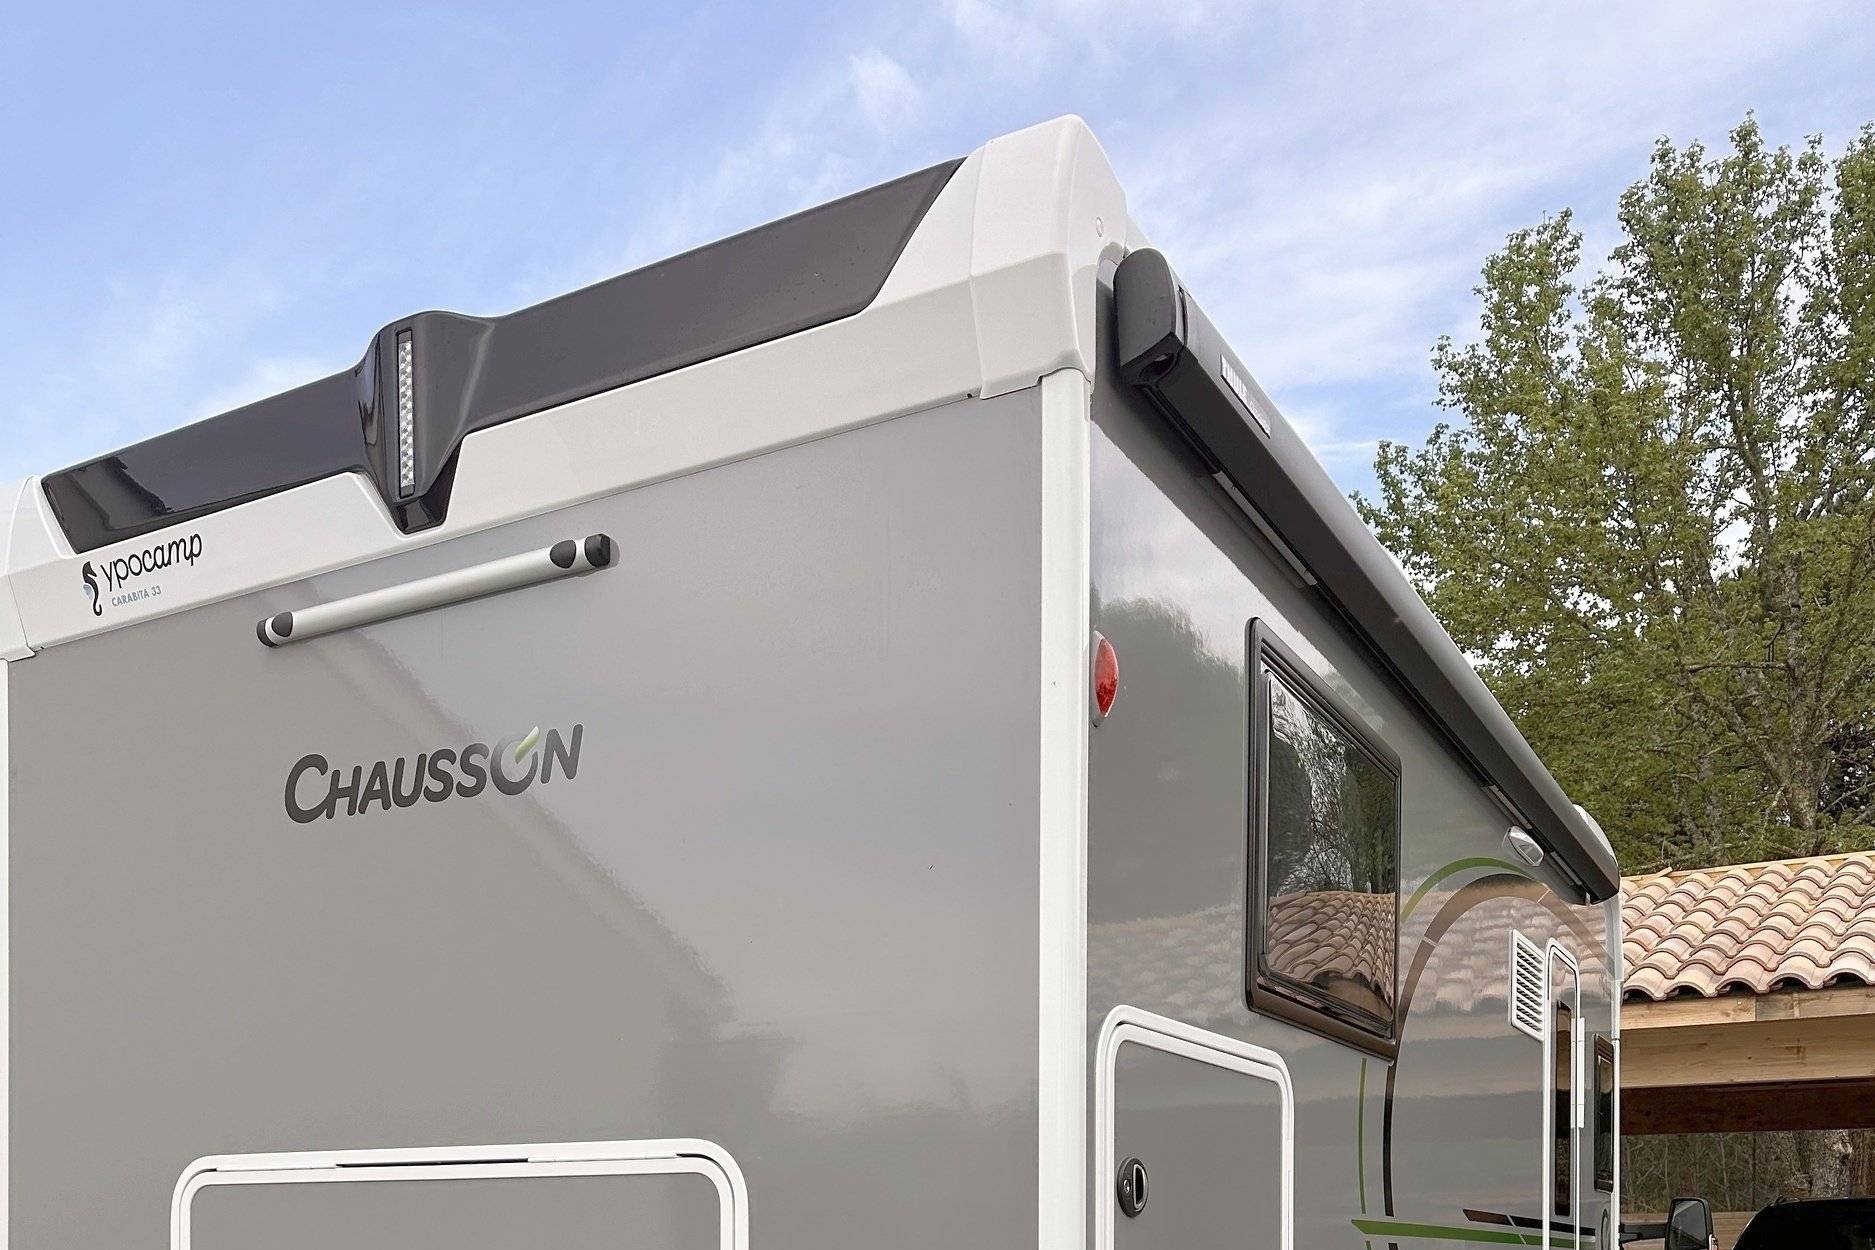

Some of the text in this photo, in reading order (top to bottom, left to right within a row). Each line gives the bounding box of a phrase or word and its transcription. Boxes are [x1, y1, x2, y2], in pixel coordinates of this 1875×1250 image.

[111, 585, 162, 607] CARABITA 33
[284, 723, 584, 824] CHAUSSON
